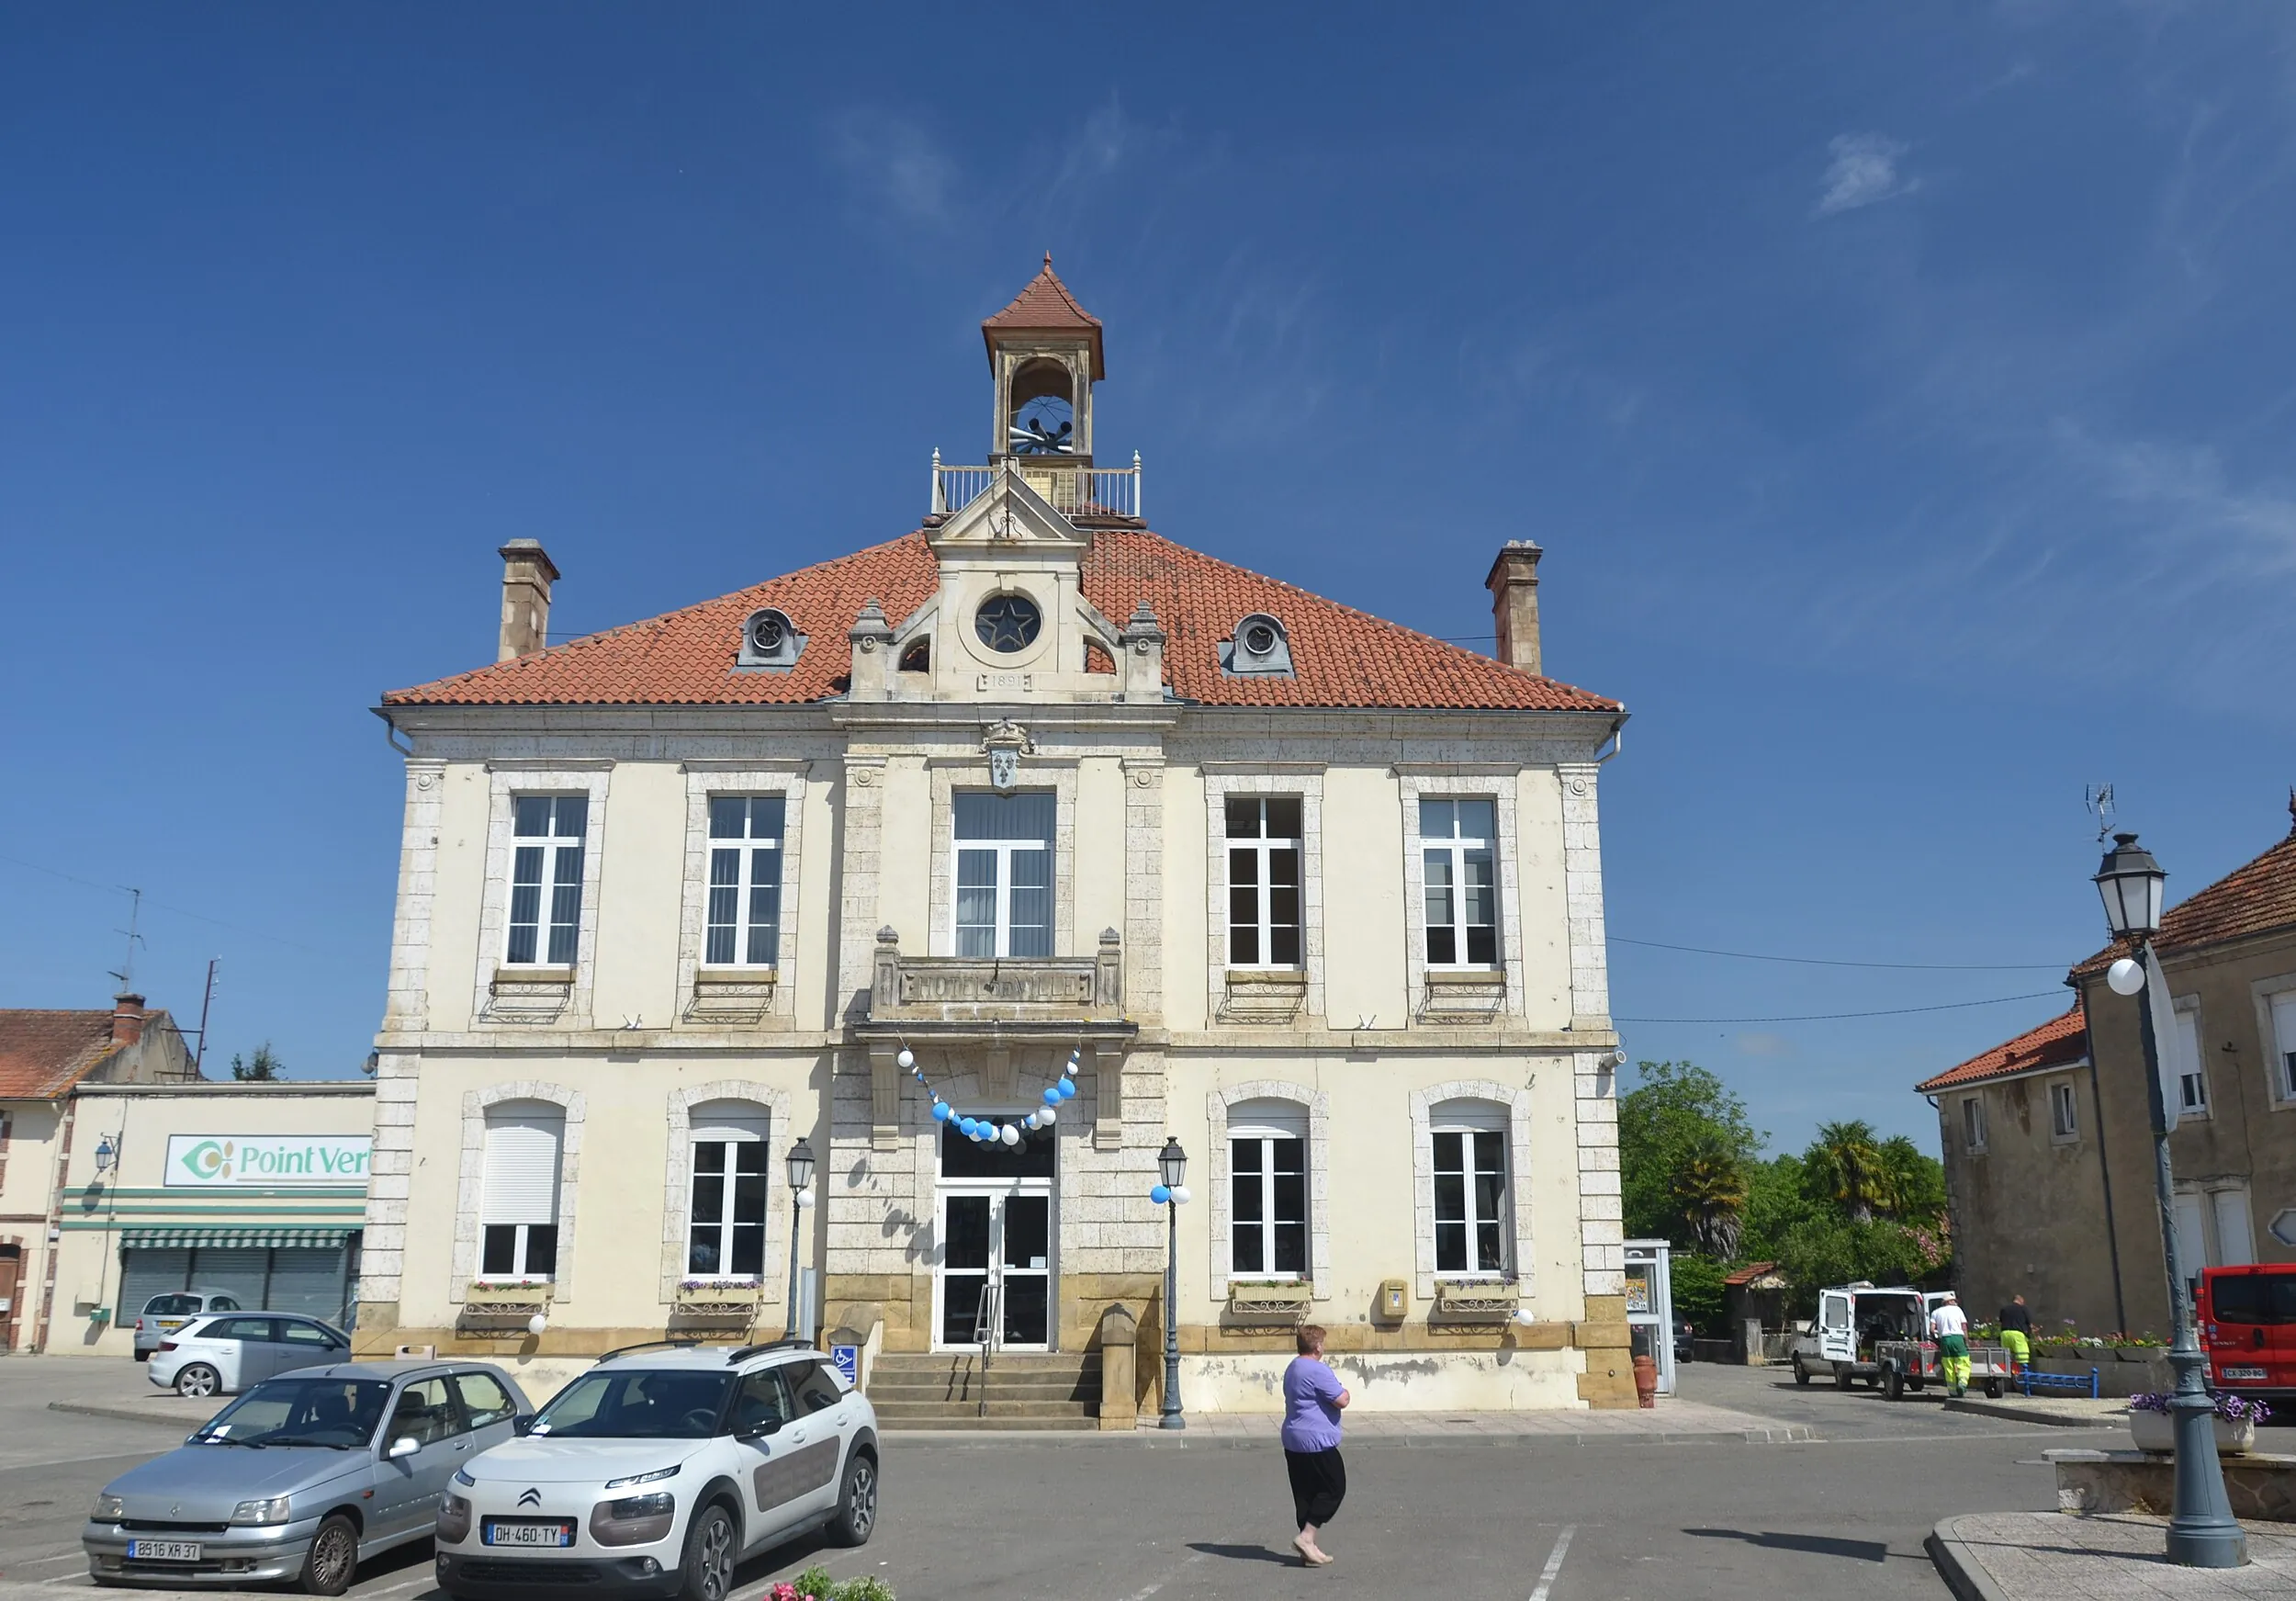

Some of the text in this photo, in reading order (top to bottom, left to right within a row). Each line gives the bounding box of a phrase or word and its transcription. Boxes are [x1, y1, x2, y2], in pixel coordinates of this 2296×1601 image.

[992, 675, 1020, 687] 1891
[1014, 975, 1076, 997] VILLE
[240, 1145, 314, 1174] Point
[183, 1544, 197, 1559] 37
